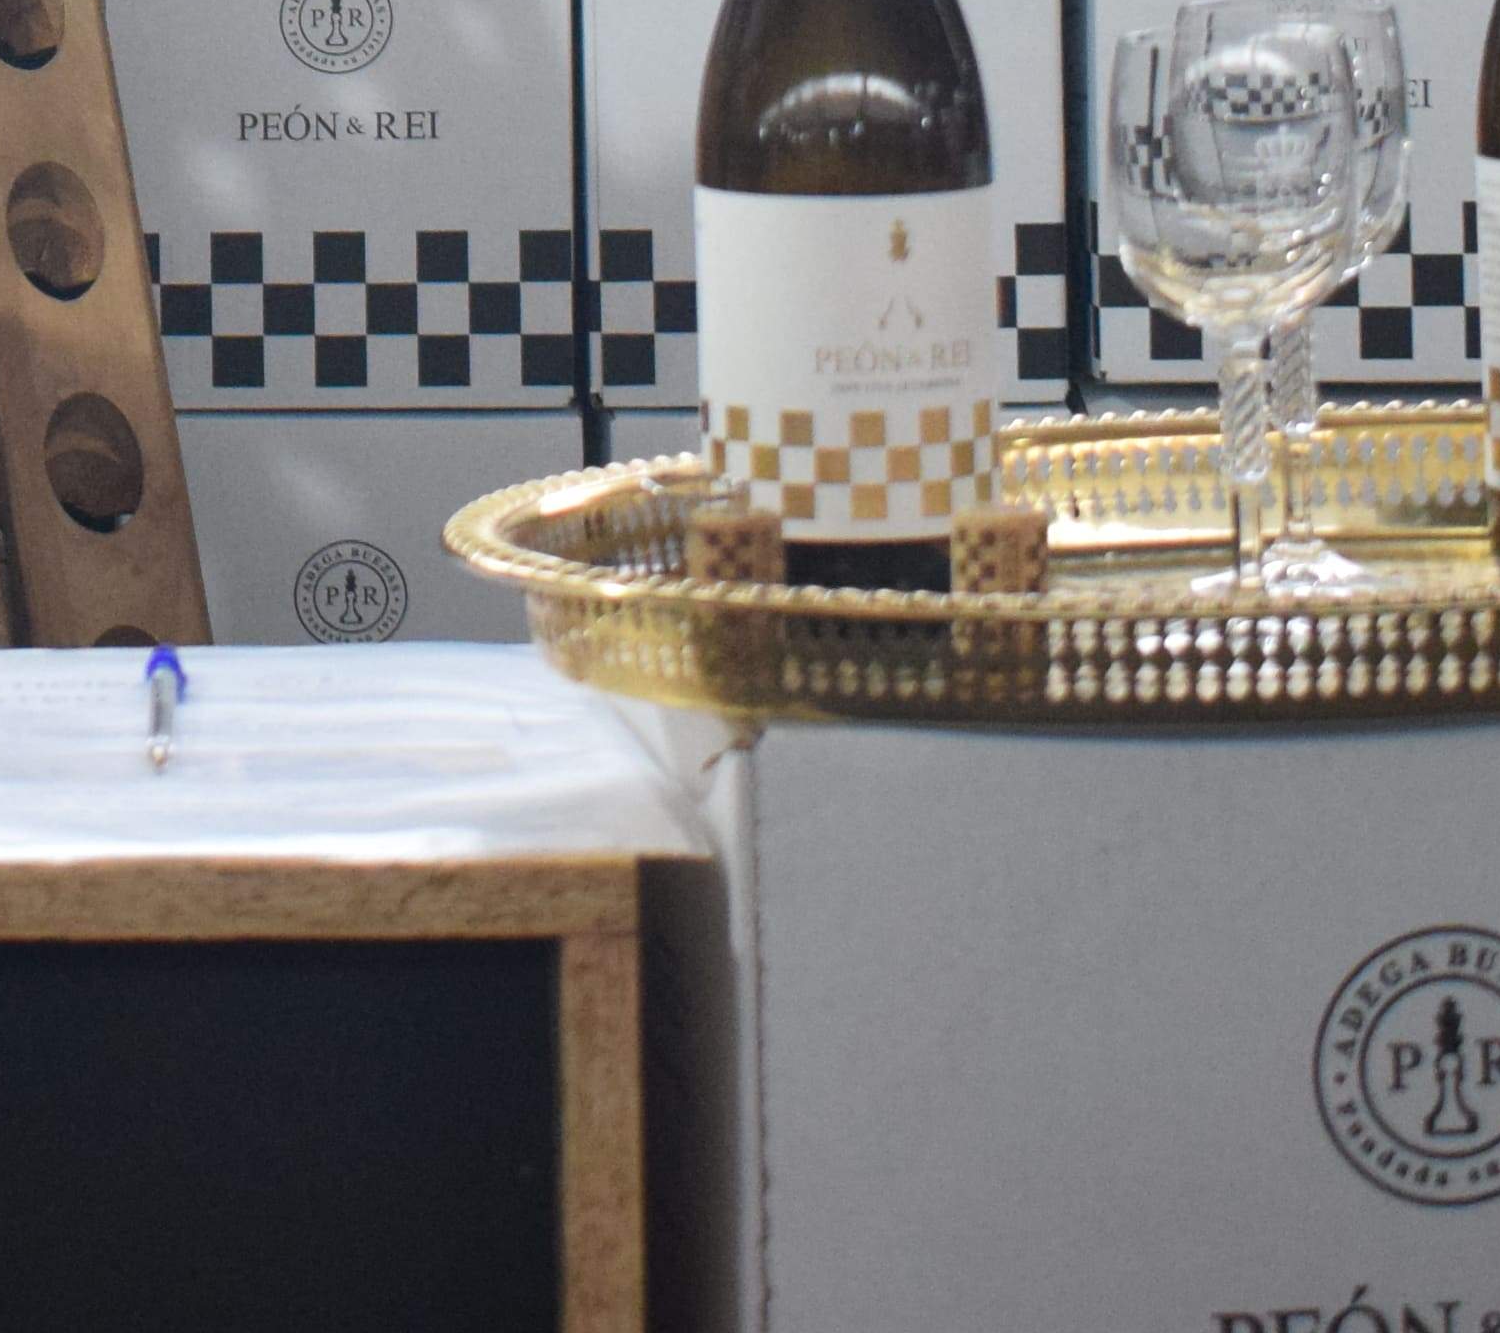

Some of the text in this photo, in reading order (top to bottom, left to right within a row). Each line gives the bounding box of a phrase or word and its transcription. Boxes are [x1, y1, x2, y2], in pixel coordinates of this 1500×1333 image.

[311, 8, 366, 27] P R
[238, 104, 439, 142] PEÓN & REI
[326, 586, 381, 606] P R
[1332, 951, 1432, 1058] ADEGA
[1387, 1040, 1424, 1095] P
